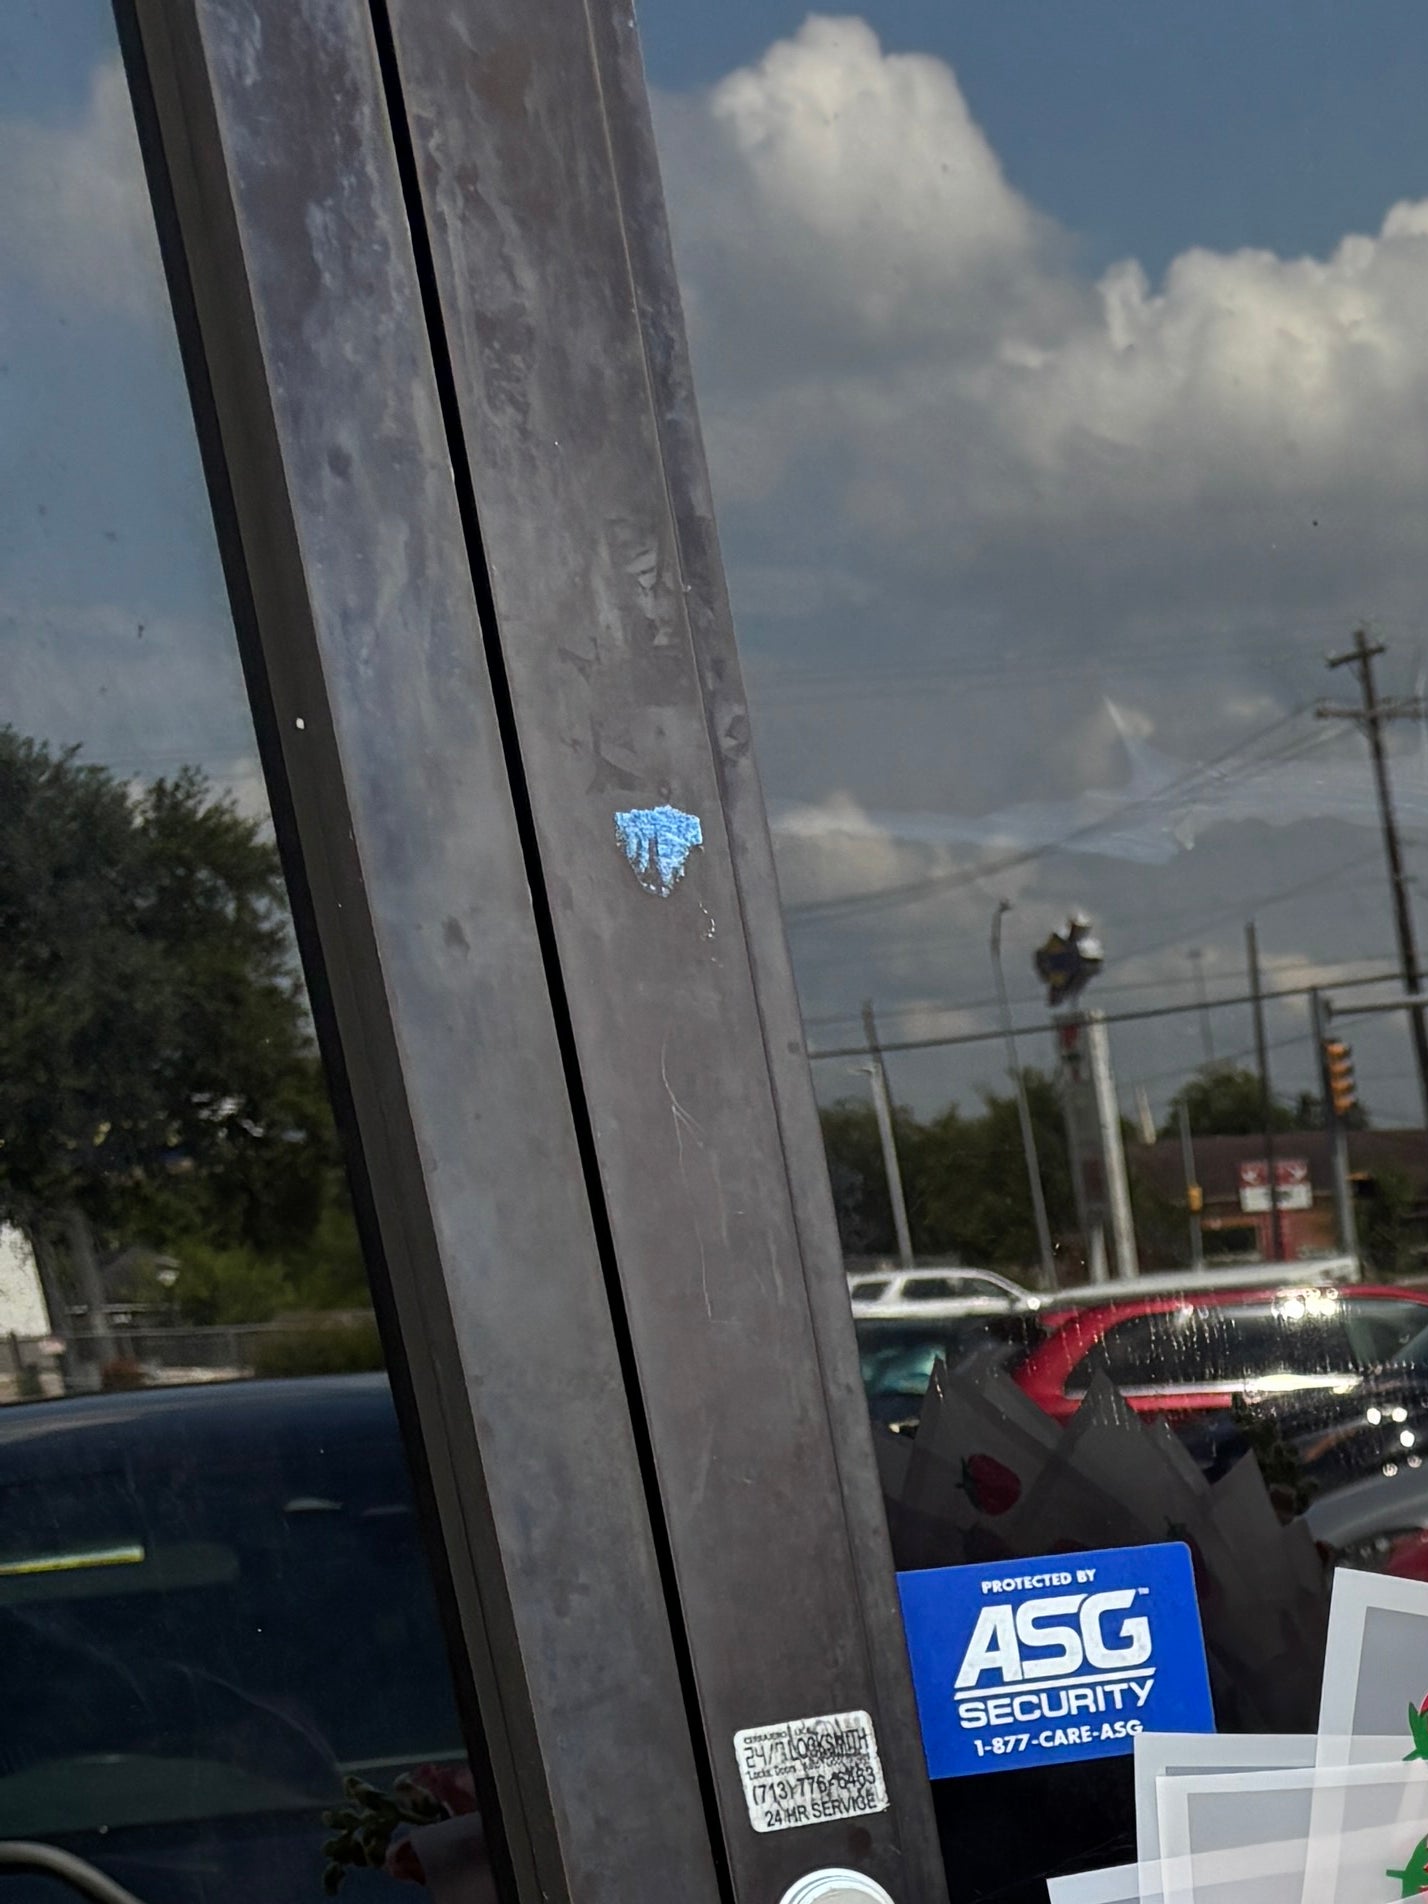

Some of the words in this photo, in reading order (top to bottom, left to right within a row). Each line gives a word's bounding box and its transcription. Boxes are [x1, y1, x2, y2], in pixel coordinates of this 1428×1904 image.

[981, 1572, 1072, 1594] PROTECTED
[1076, 1568, 1096, 1584] BY
[954, 1588, 1152, 1689] ASG
[958, 1679, 1154, 1729] SECURITY
[974, 1719, 1144, 1757] 1-877-CARE-ASG
[765, 1809, 782, 1828] 24
[786, 1804, 810, 1824] HR
[811, 1793, 877, 1819] SERVICE
